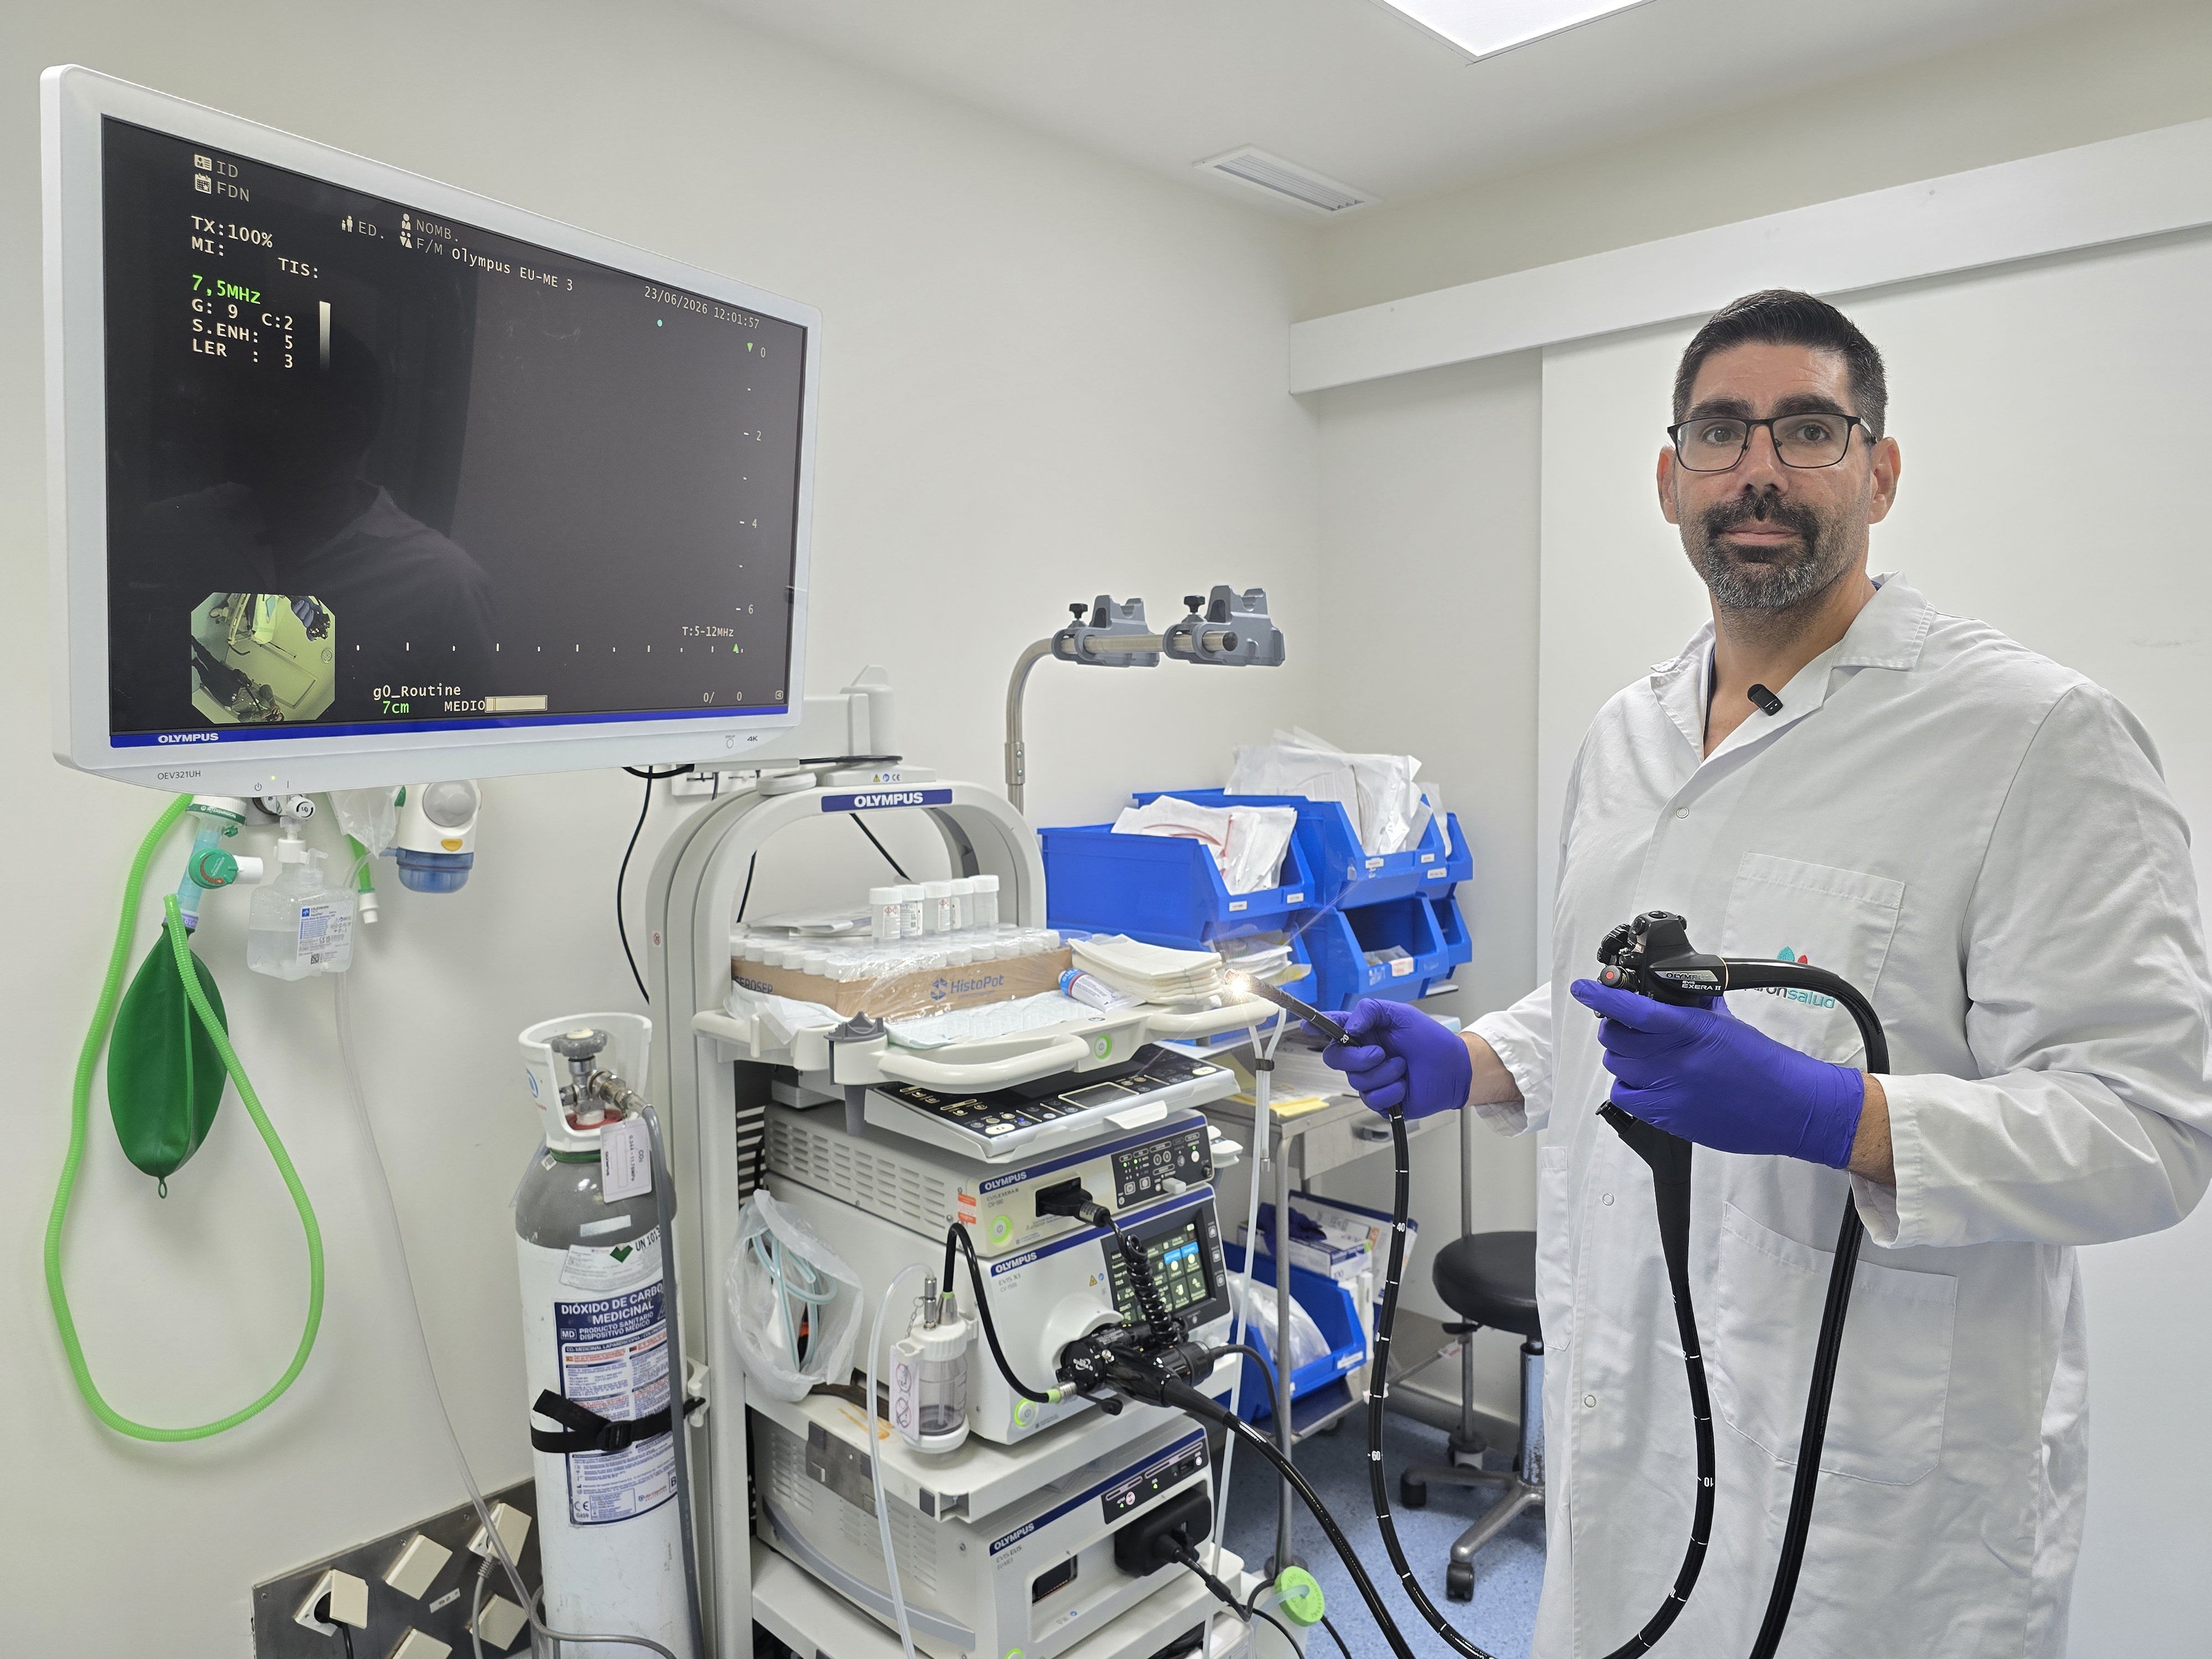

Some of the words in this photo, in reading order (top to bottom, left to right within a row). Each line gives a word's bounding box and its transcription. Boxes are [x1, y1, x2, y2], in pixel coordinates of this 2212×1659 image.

[216, 160, 238, 178] ID
[217, 181, 250, 202] FDN
[191, 215, 273, 248] TX:100%
[359, 221, 384, 239] ED.
[416, 220, 459, 242] NOMB.
[191, 236, 224, 256] MI:
[278, 258, 318, 278] TIS:
[417, 237, 443, 255] F/M
[520, 267, 558, 288] EU-ME
[567, 279, 573, 291] 3
[192, 299, 212, 314] G:
[228, 305, 238, 319] 9
[645, 285, 708, 315] 23/06/2026
[713, 306, 760, 330] 12:01:57
[192, 320, 259, 343] S.ENH:
[285, 335, 293, 349] 5
[760, 346, 766, 358] 0
[285, 355, 293, 369] 3
[756, 430, 761, 441] 2
[752, 518, 758, 529] 4
[748, 604, 754, 614] 6
[736, 691, 743, 702] 0
[382, 700, 410, 714] 7cm
[444, 700, 486, 712] MEDIO
[158, 732, 219, 744] OLYMPUS
[157, 770, 201, 780] OEV321UH
[854, 792, 924, 808] OLYMPUS
[950, 974, 1005, 994] HistoPot
[1666, 972, 1713, 981] OLYMPUS
[1340, 1034, 1349, 1044] 20
[984, 1171, 1027, 1191] OLYMPUS
[1396, 1222, 1405, 1233] 40
[635, 1238, 646, 1251] UN
[995, 1252, 1037, 1274] OLYMPUS
[561, 1301, 609, 1315] DIÓXIDO
[612, 1296, 628, 1310] DE
[629, 1282, 663, 1305] CARBO
[592, 1301, 654, 1325] MEDICINAL
[579, 1323, 618, 1334] PRODUCTO
[580, 1329, 624, 1341] DISPOSITIVO
[1371, 1450, 1381, 1461] 60
[1704, 1477, 1714, 1488] 10
[994, 1523, 1035, 1550] OLYMPUS
